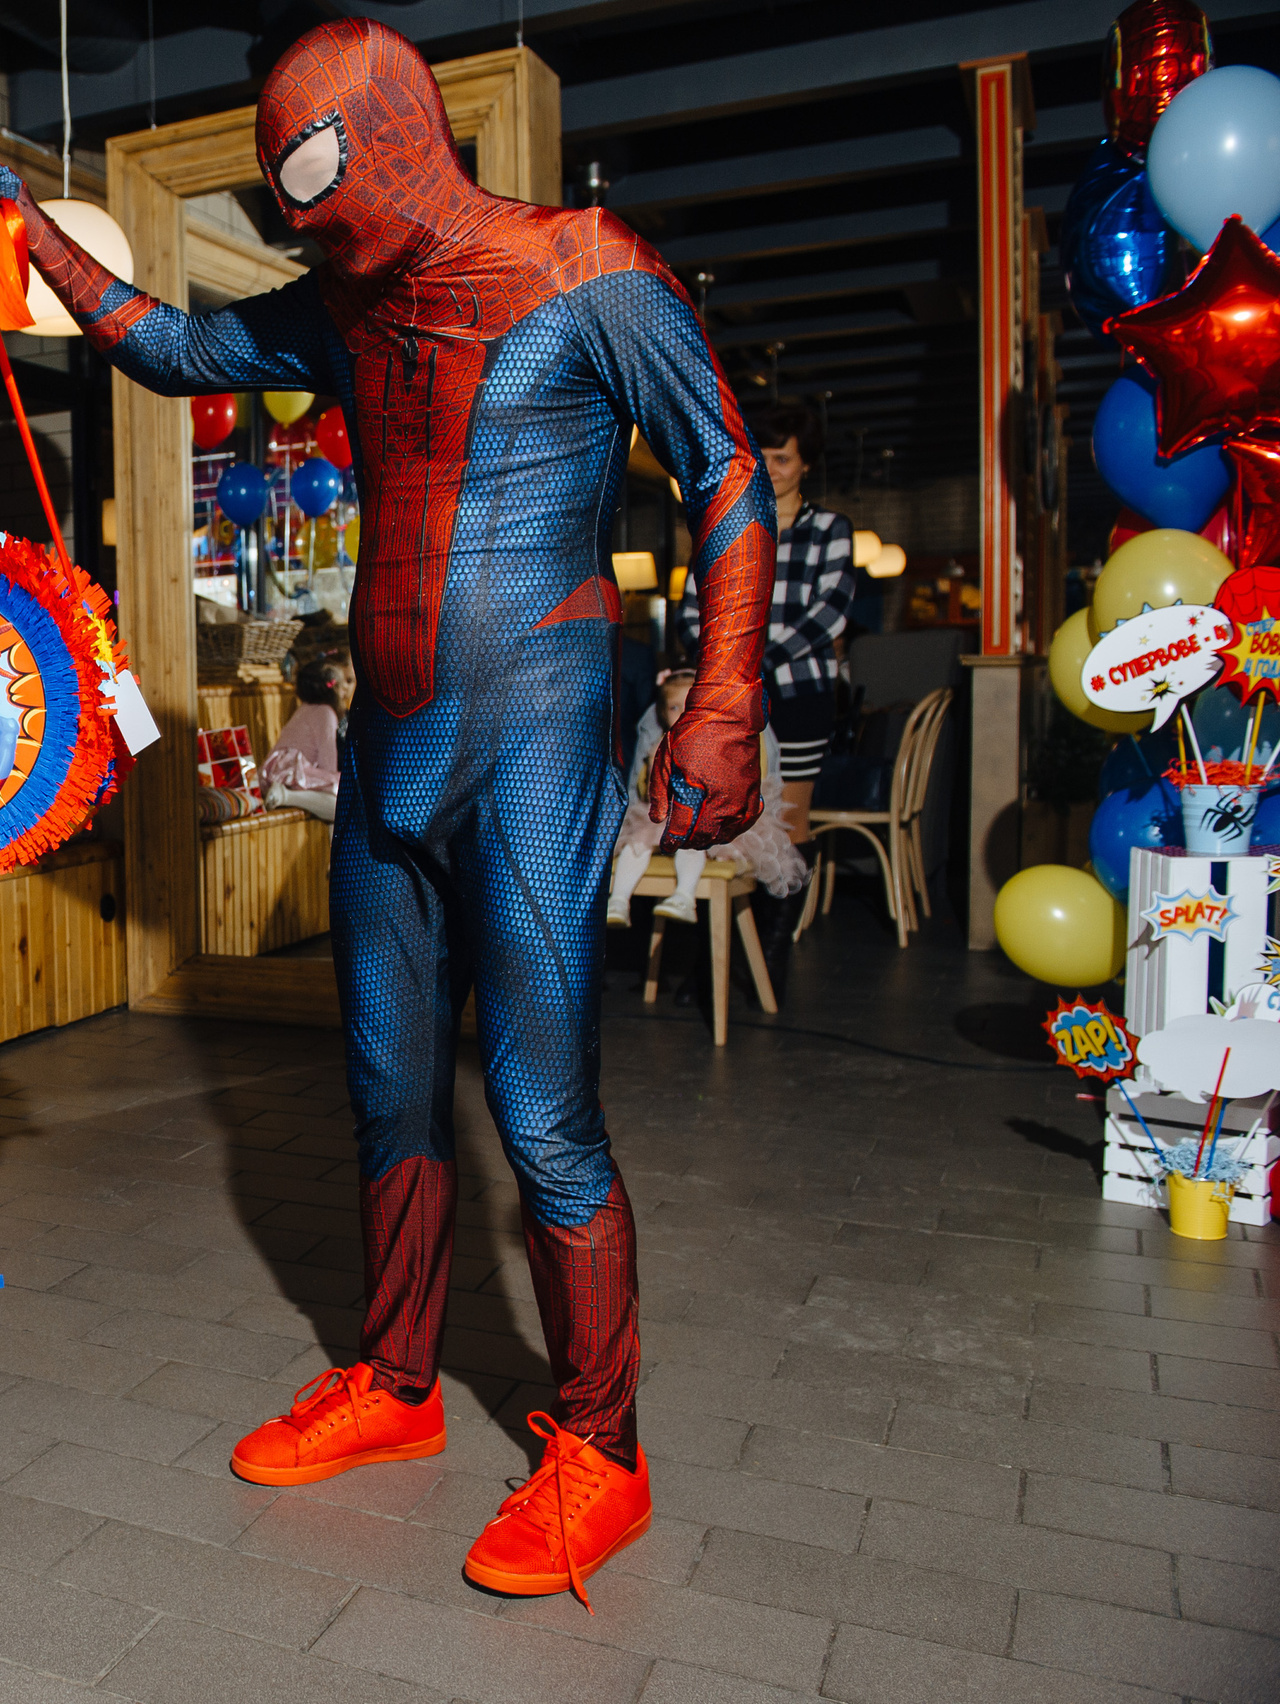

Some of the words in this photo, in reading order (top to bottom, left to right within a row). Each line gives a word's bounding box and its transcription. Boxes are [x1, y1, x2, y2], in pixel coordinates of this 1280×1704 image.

[1108, 633, 1202, 686] СУПЕРВОВЕ
[1250, 632, 1280, 655] ВОВ
[1159, 902, 1229, 927] SPLAT!
[1054, 1014, 1124, 1064] ZAP!
